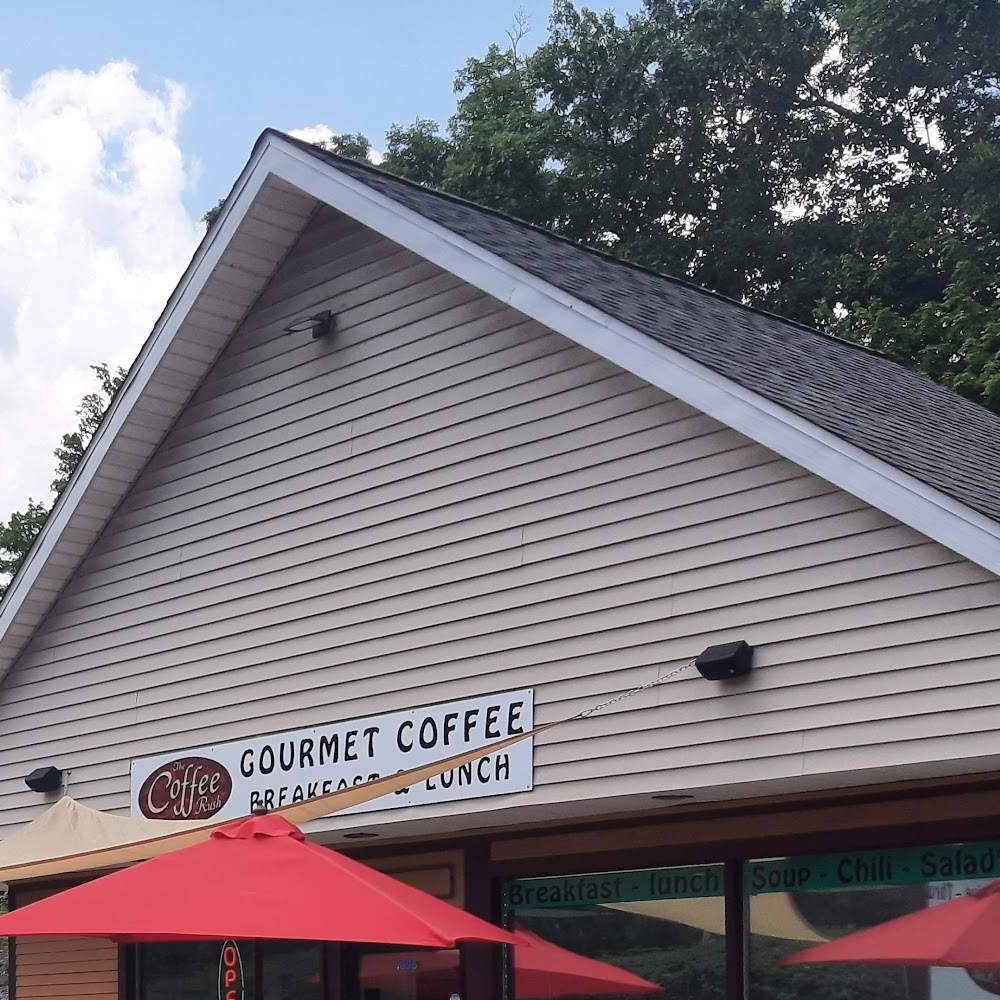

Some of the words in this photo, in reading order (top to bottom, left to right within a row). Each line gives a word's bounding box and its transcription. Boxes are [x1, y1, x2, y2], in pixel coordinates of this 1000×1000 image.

[240, 727, 380, 778] GOURMET
[396, 701, 524, 753] COFFEE
[173, 761, 185, 771] The
[147, 763, 221, 818] Coffee
[195, 795, 222, 815] Rush
[752, 866, 812, 890] Soup
[837, 855, 893, 883] Chili
[921, 847, 1000, 878] Salad
[509, 878, 624, 906] Breakfast
